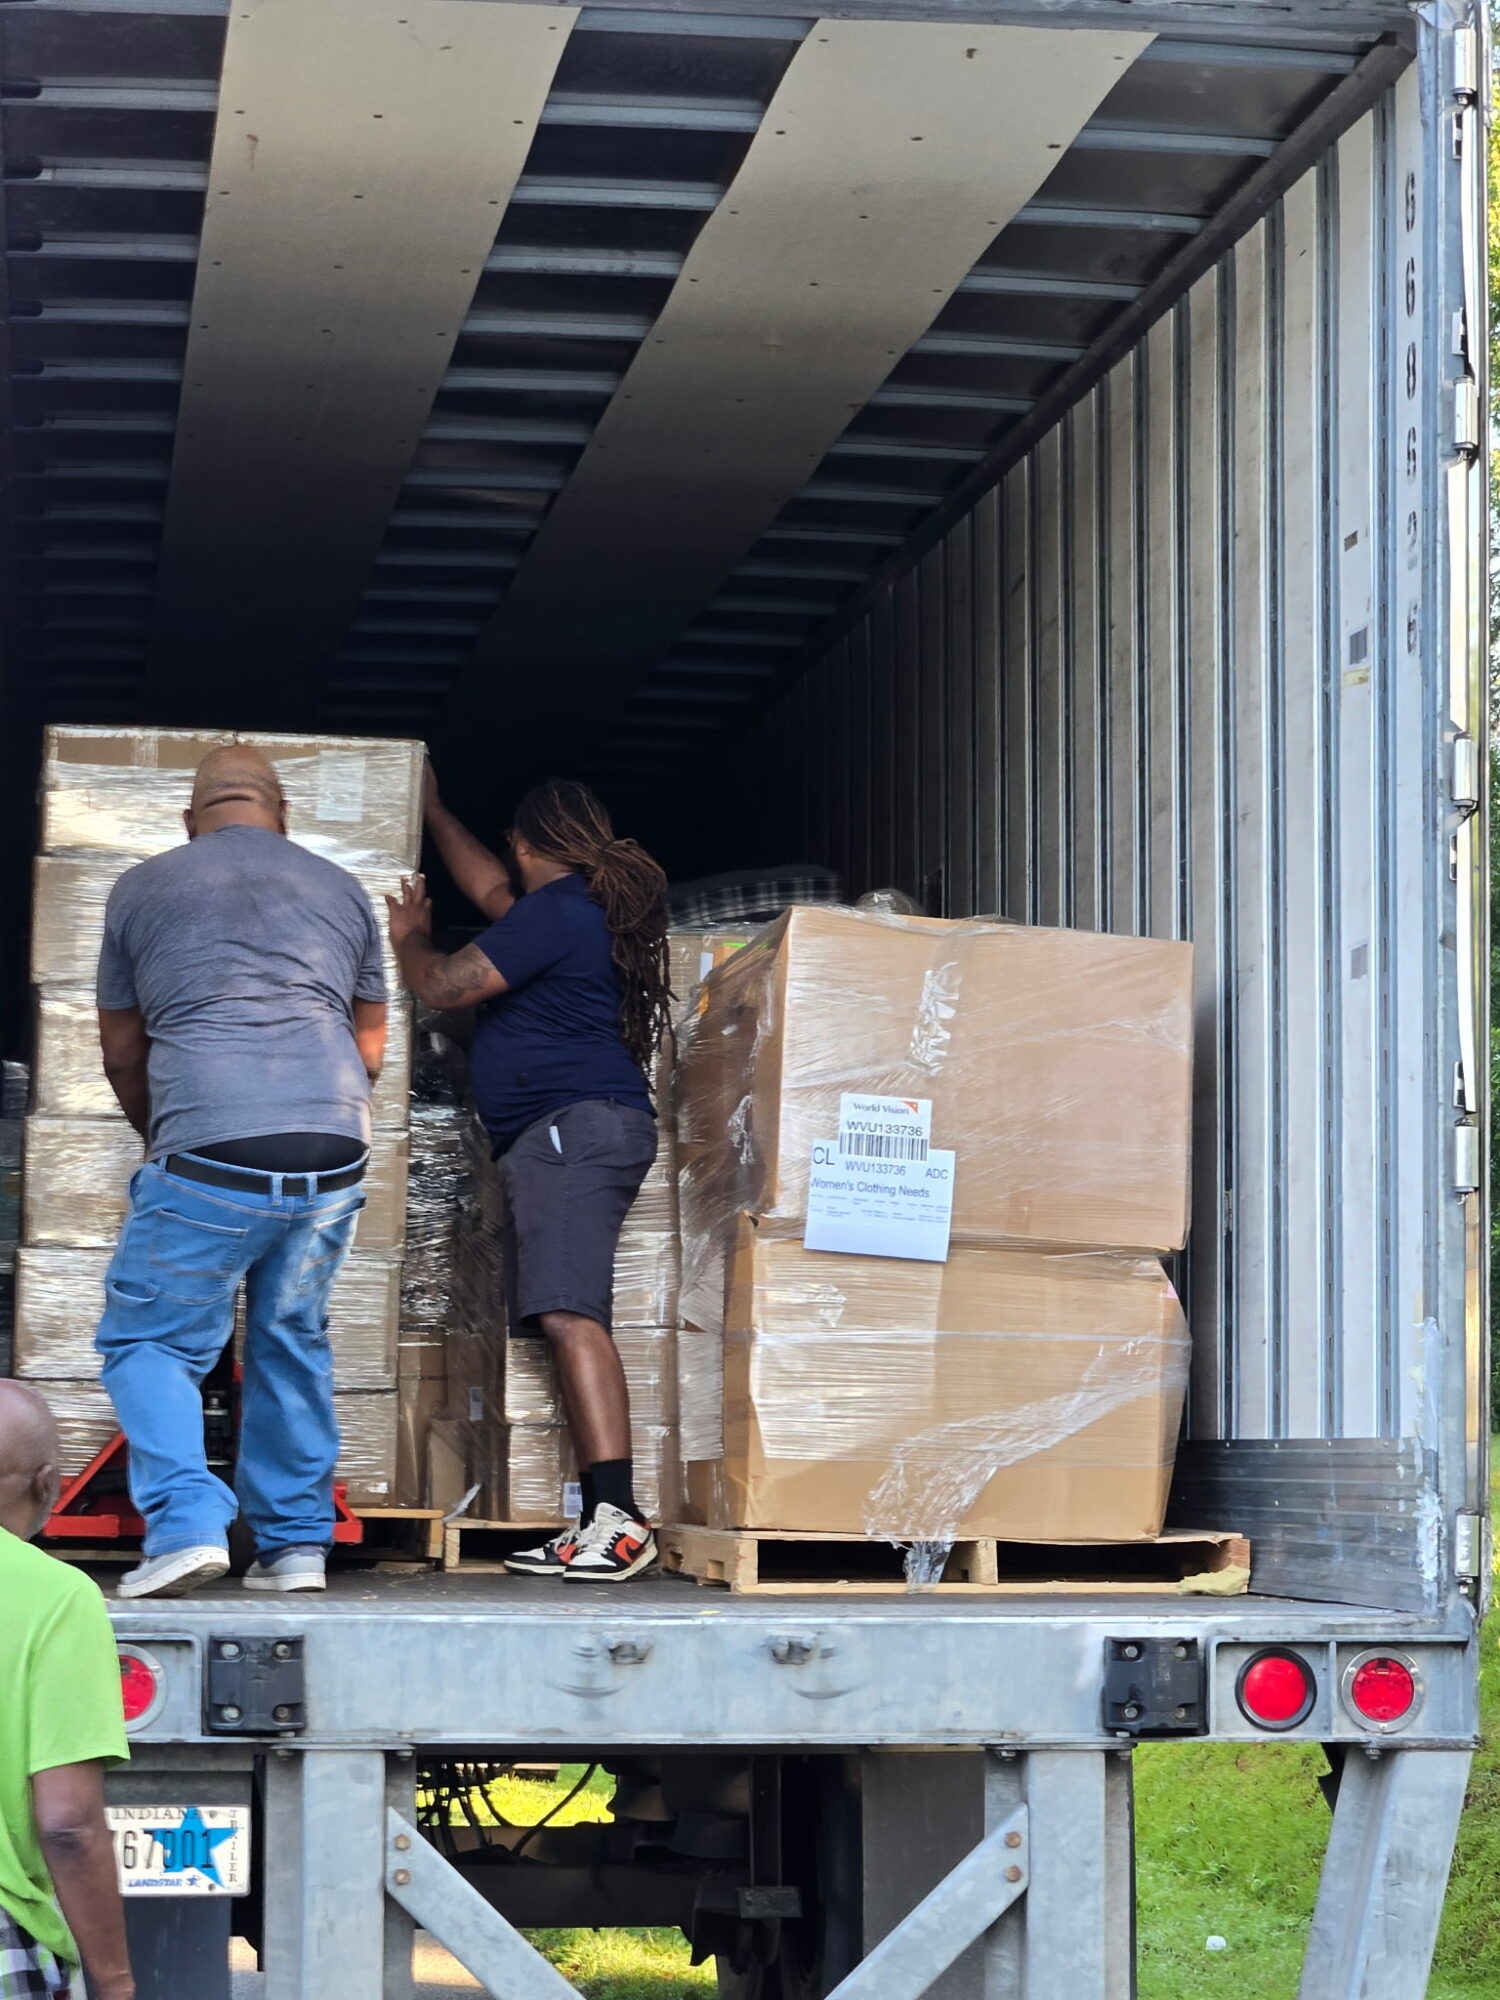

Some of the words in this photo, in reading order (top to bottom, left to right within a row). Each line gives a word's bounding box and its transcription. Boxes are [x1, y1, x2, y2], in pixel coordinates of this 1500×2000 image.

[853, 1103, 881, 1113] World
[882, 1105, 909, 1115] Vision
[846, 1120, 923, 1137] WVU133736
[812, 1146, 835, 1166] CL
[845, 1160, 907, 1176] WVU133736
[925, 1167, 949, 1180] ADC
[810, 1177, 854, 1192] Women's
[856, 1181, 896, 1198] Clothing
[899, 1185, 930, 1198] Needs
[109, 1830, 214, 1869] 67001
[127, 1878, 183, 1888] LANDSTAR
